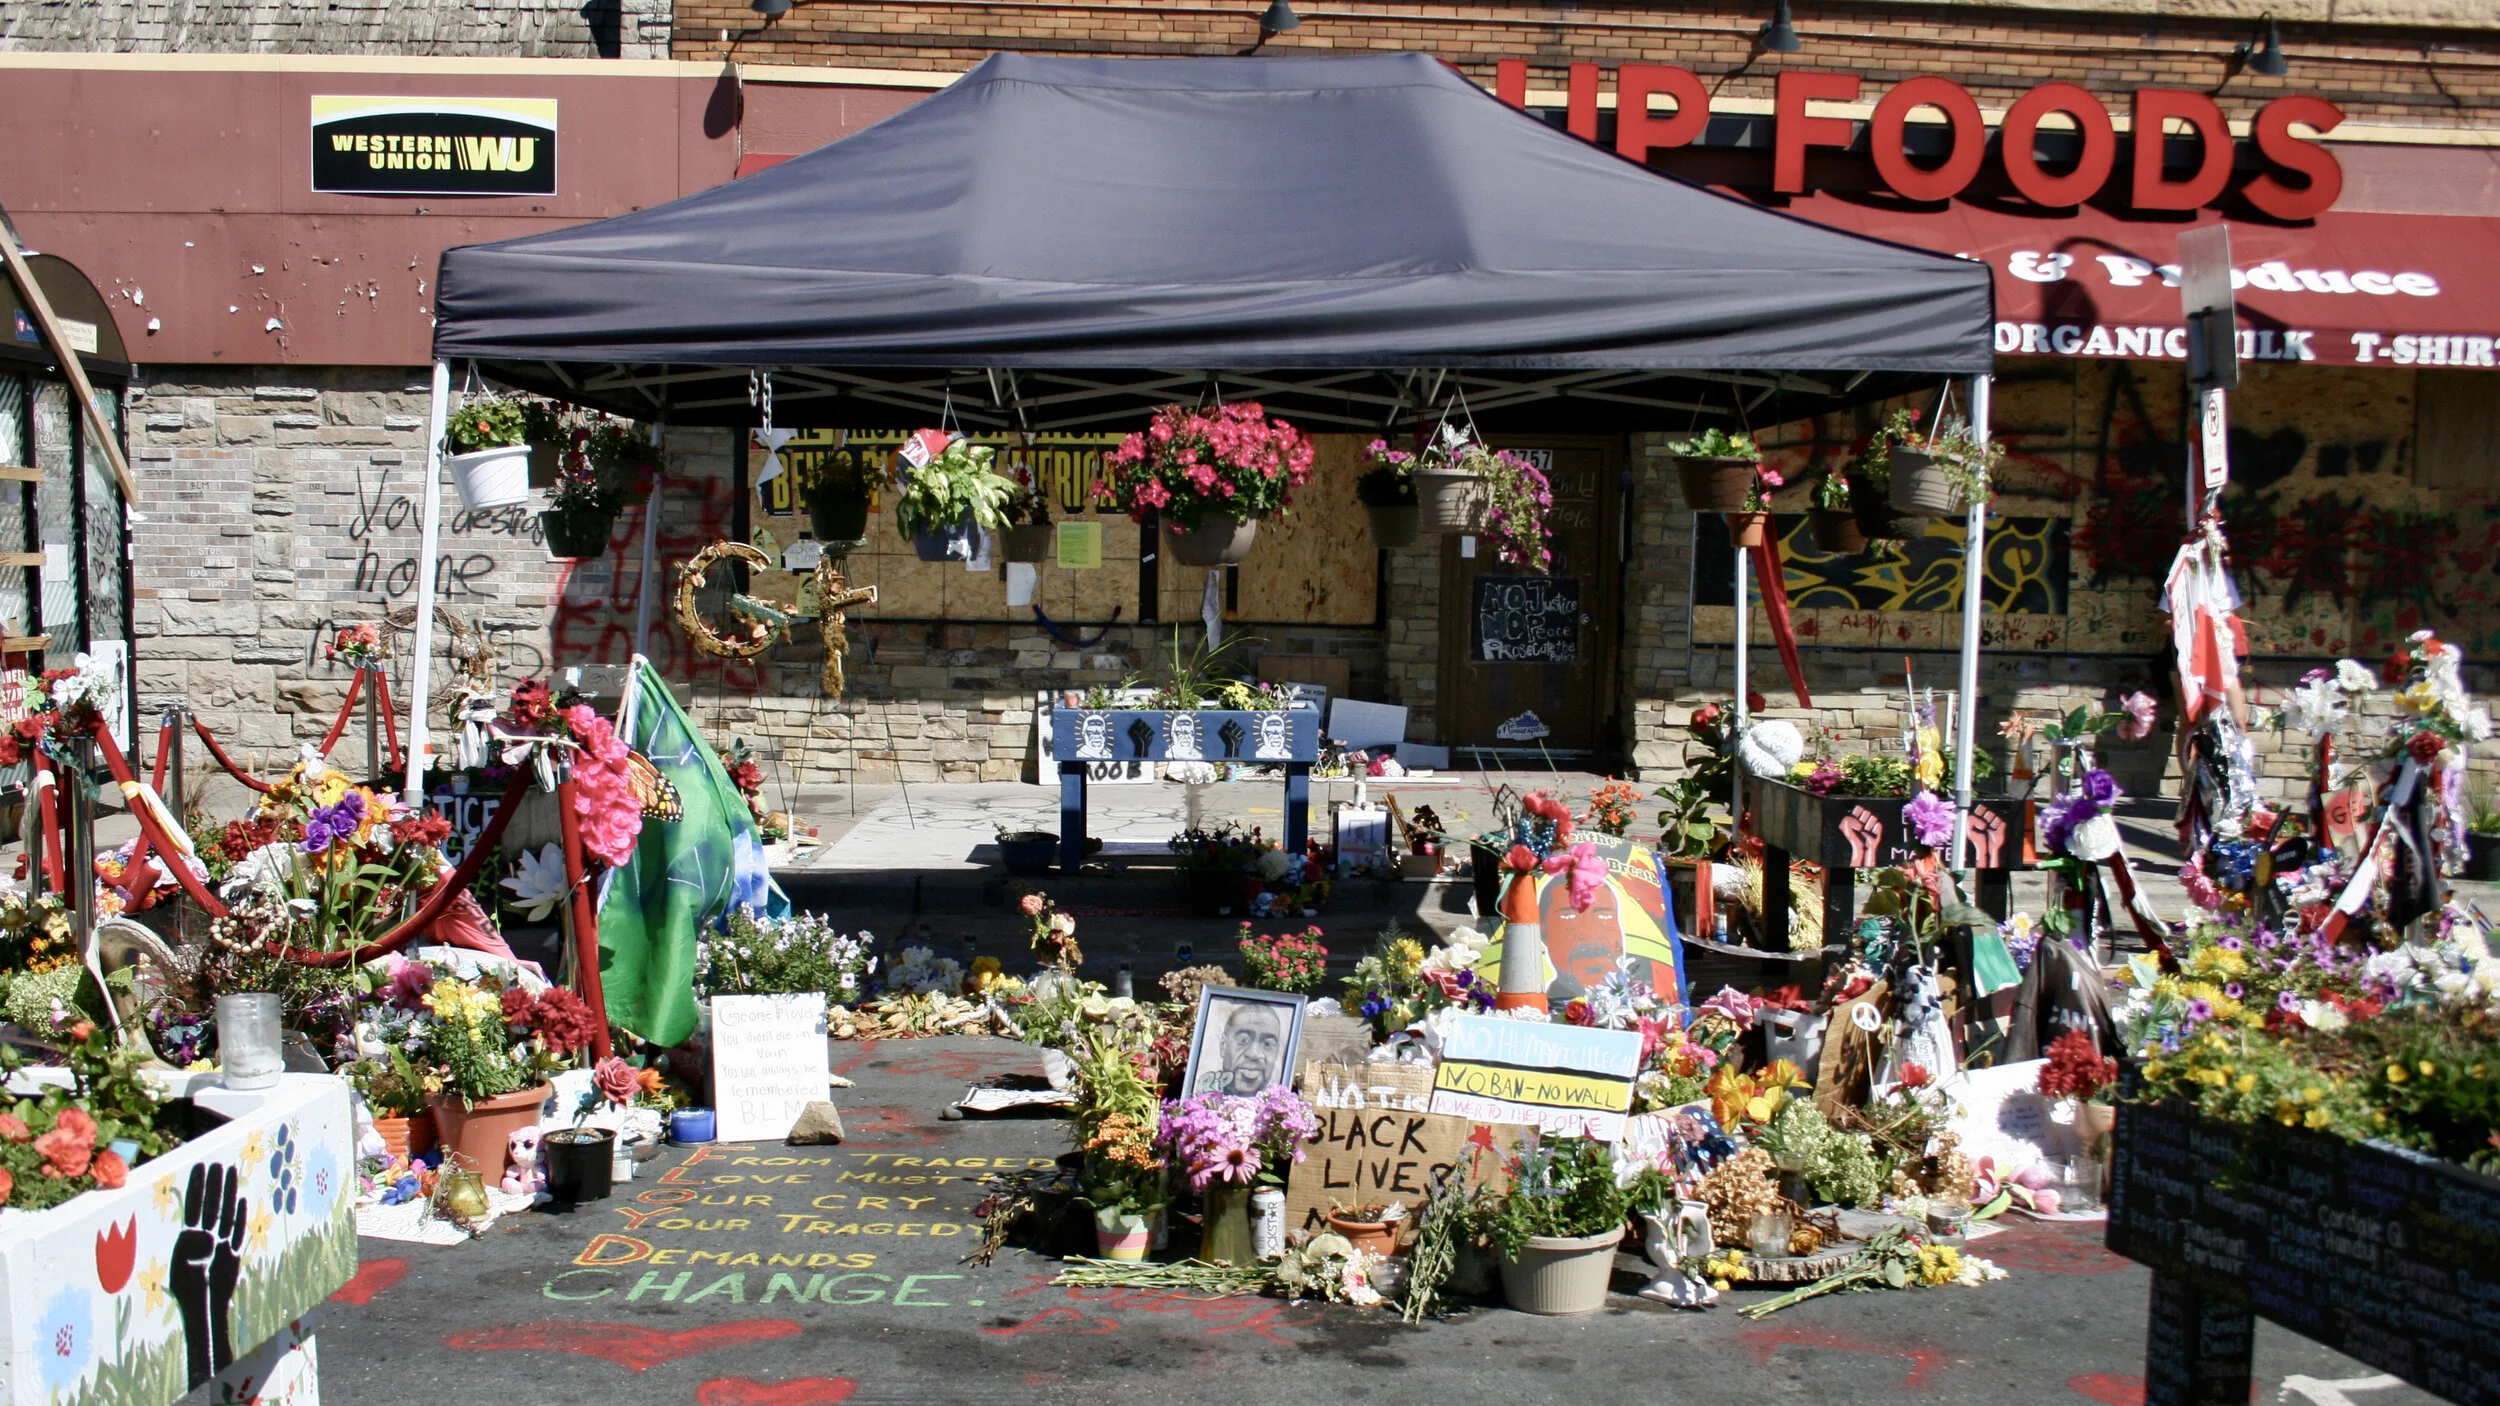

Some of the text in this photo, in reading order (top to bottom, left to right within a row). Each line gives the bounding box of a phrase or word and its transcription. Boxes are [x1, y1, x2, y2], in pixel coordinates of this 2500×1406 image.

[331, 134, 451, 152] WESTERN
[1773, 70, 2346, 221] FOODS
[368, 153, 451, 170] UNION
[2008, 250, 2074, 282] &
[1994, 322, 2188, 359] ORGANIC
[2236, 329, 2317, 360] ILK
[718, 998, 814, 1027] George Floyd
[720, 1031, 739, 1047] You
[721, 1063, 738, 1079] You
[804, 1063, 818, 1074] be
[1445, 1065, 1486, 1095] NO
[1565, 1086, 1616, 1109] WALL
[1434, 1095, 1483, 1118] POWER
[1488, 1103, 1502, 1121] TO
[1307, 1110, 1428, 1155] BLACK
[682, 1146, 1056, 1168] FROM TRAGED
[657, 1166, 813, 1185] LOVE
[836, 1171, 962, 1185] MUST
[637, 1188, 774, 1206] OUR
[613, 1207, 752, 1231] YOUR
[572, 1233, 878, 1269] DEMANDS
